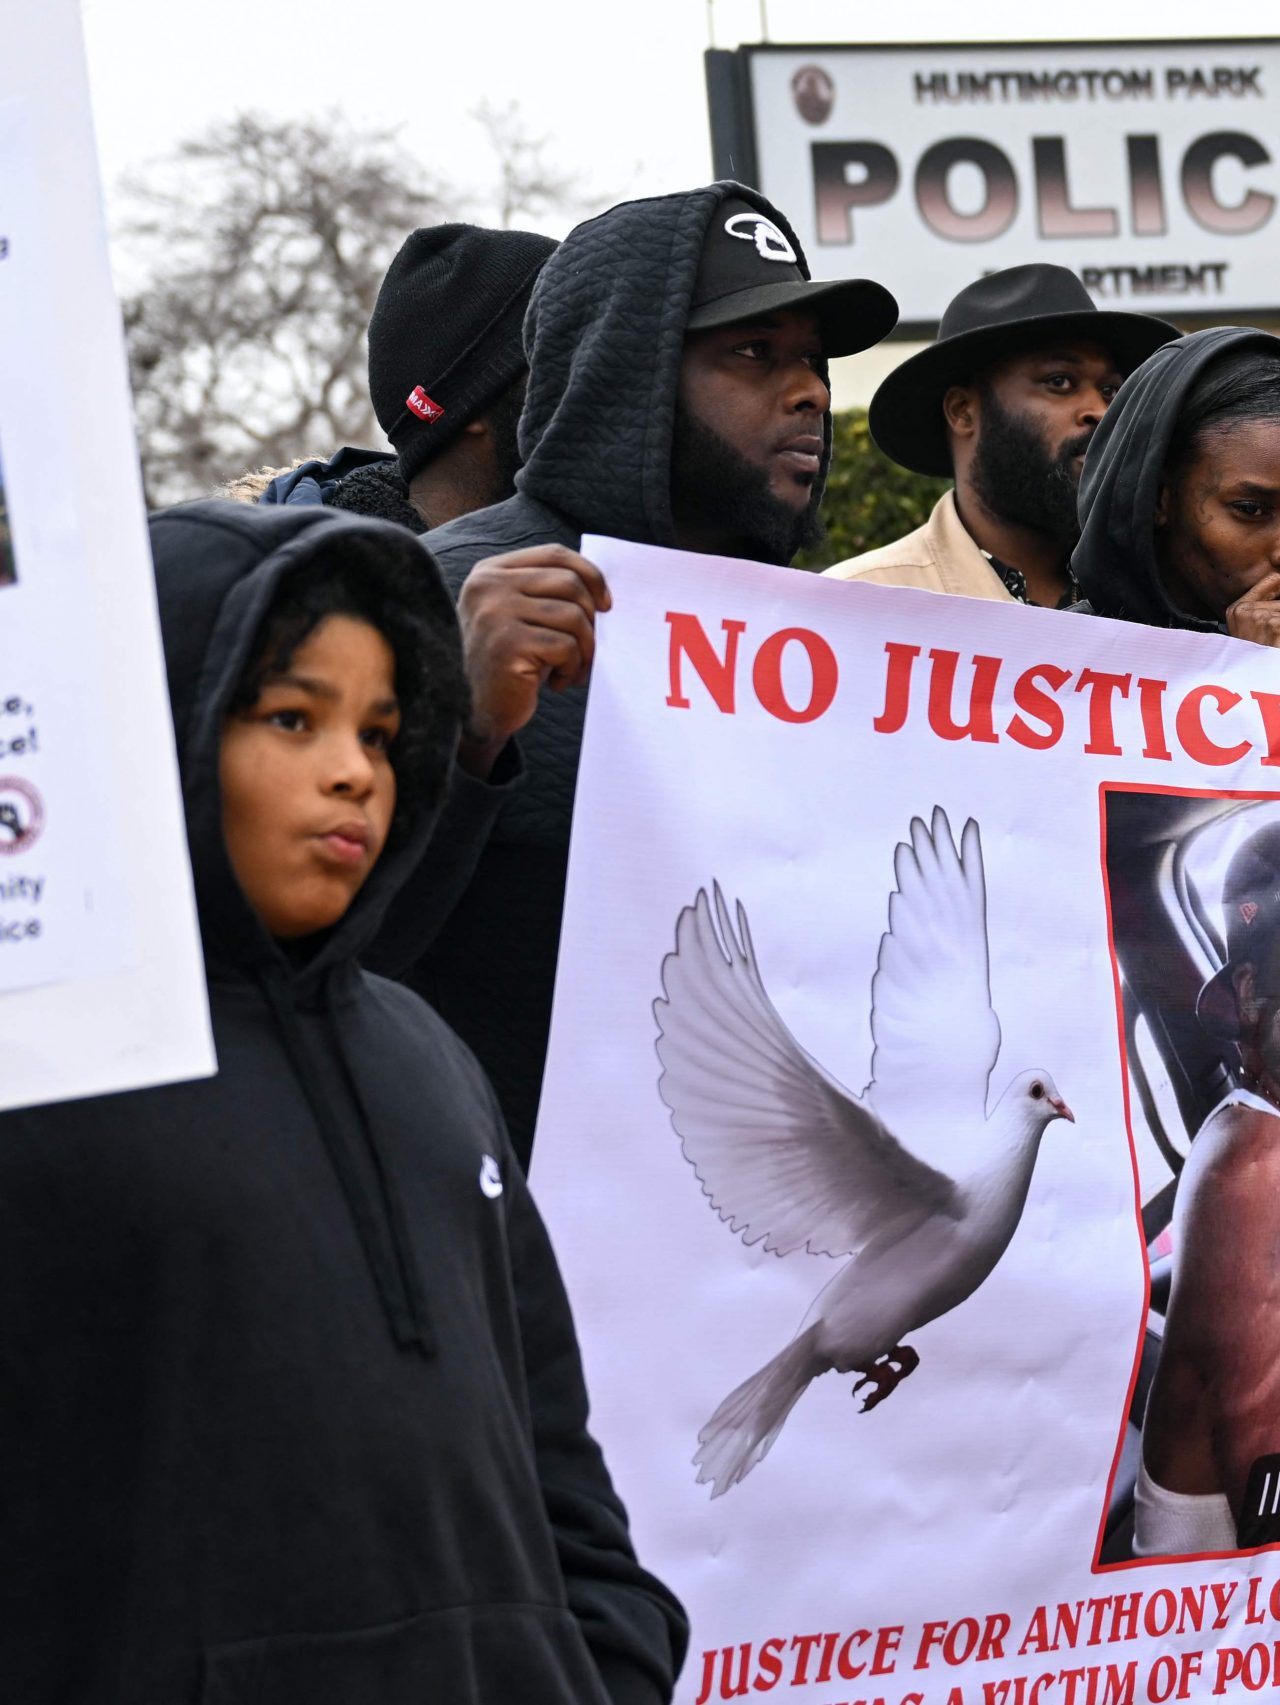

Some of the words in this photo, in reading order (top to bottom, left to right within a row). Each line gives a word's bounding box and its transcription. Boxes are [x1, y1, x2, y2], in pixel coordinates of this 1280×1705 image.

[914, 69, 1155, 104] HUNTINGTON
[1165, 67, 1264, 98] PARK
[664, 611, 838, 724] NO
[695, 1626, 904, 1705] JUSTICE
[913, 1612, 1011, 1671] FOR
[1018, 1581, 1239, 1656] ANTHONY
[1147, 1650, 1203, 1704] OF
